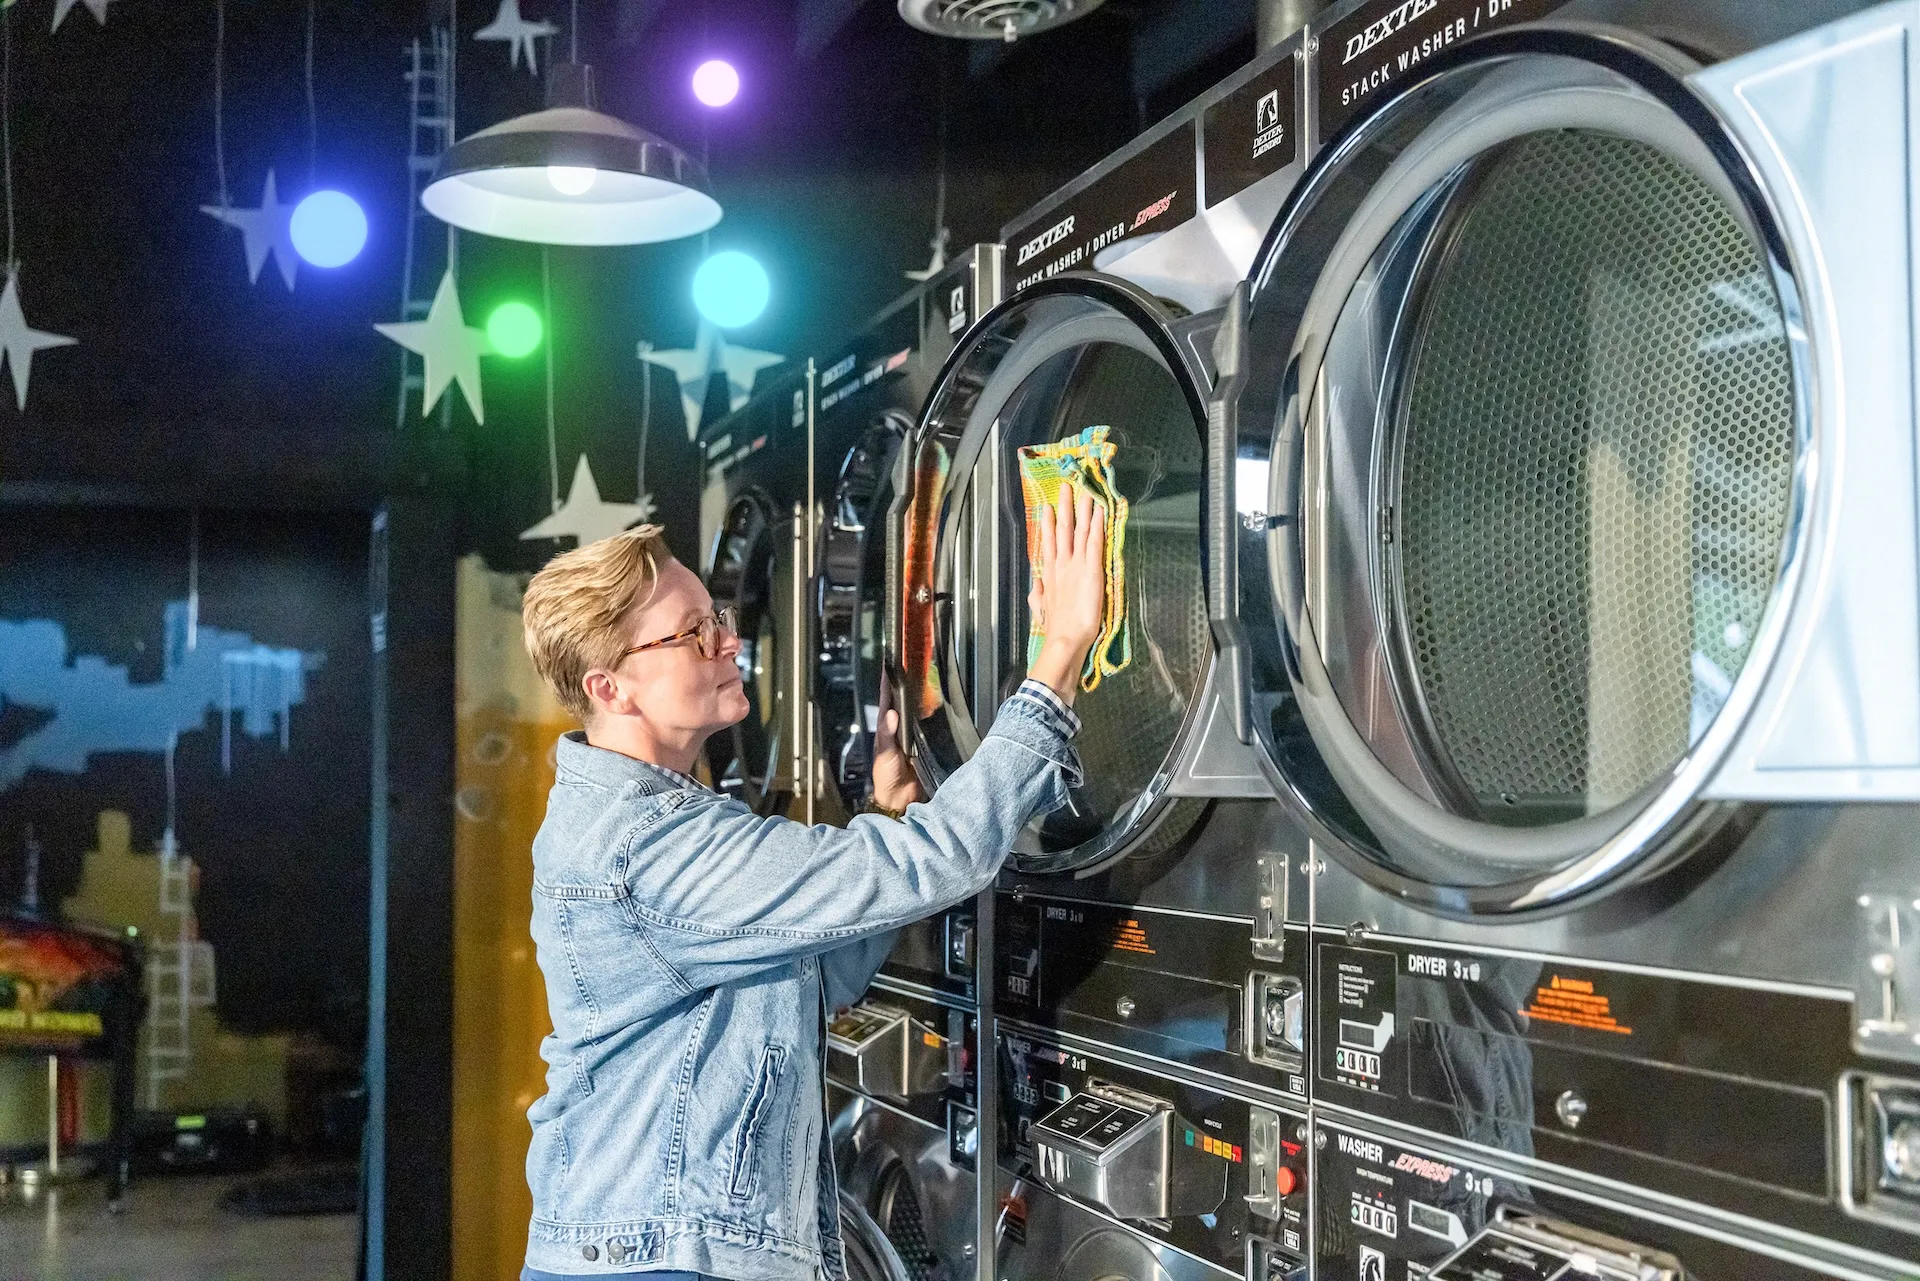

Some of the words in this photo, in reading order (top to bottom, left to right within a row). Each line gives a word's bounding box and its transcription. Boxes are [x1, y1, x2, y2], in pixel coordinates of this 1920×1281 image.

[1342, 63, 1390, 106] STACK
[1398, 17, 1466, 72] WASHER
[1473, 7, 1480, 28] /
[1016, 215, 1076, 267] DEXTER
[1046, 246, 1083, 278] WASHER
[1093, 222, 1125, 252] DRYER
[1408, 954, 1448, 977] DRYER
[1338, 1134, 1383, 1164] WASHER
[1395, 1153, 1453, 1184] EXPRESS
